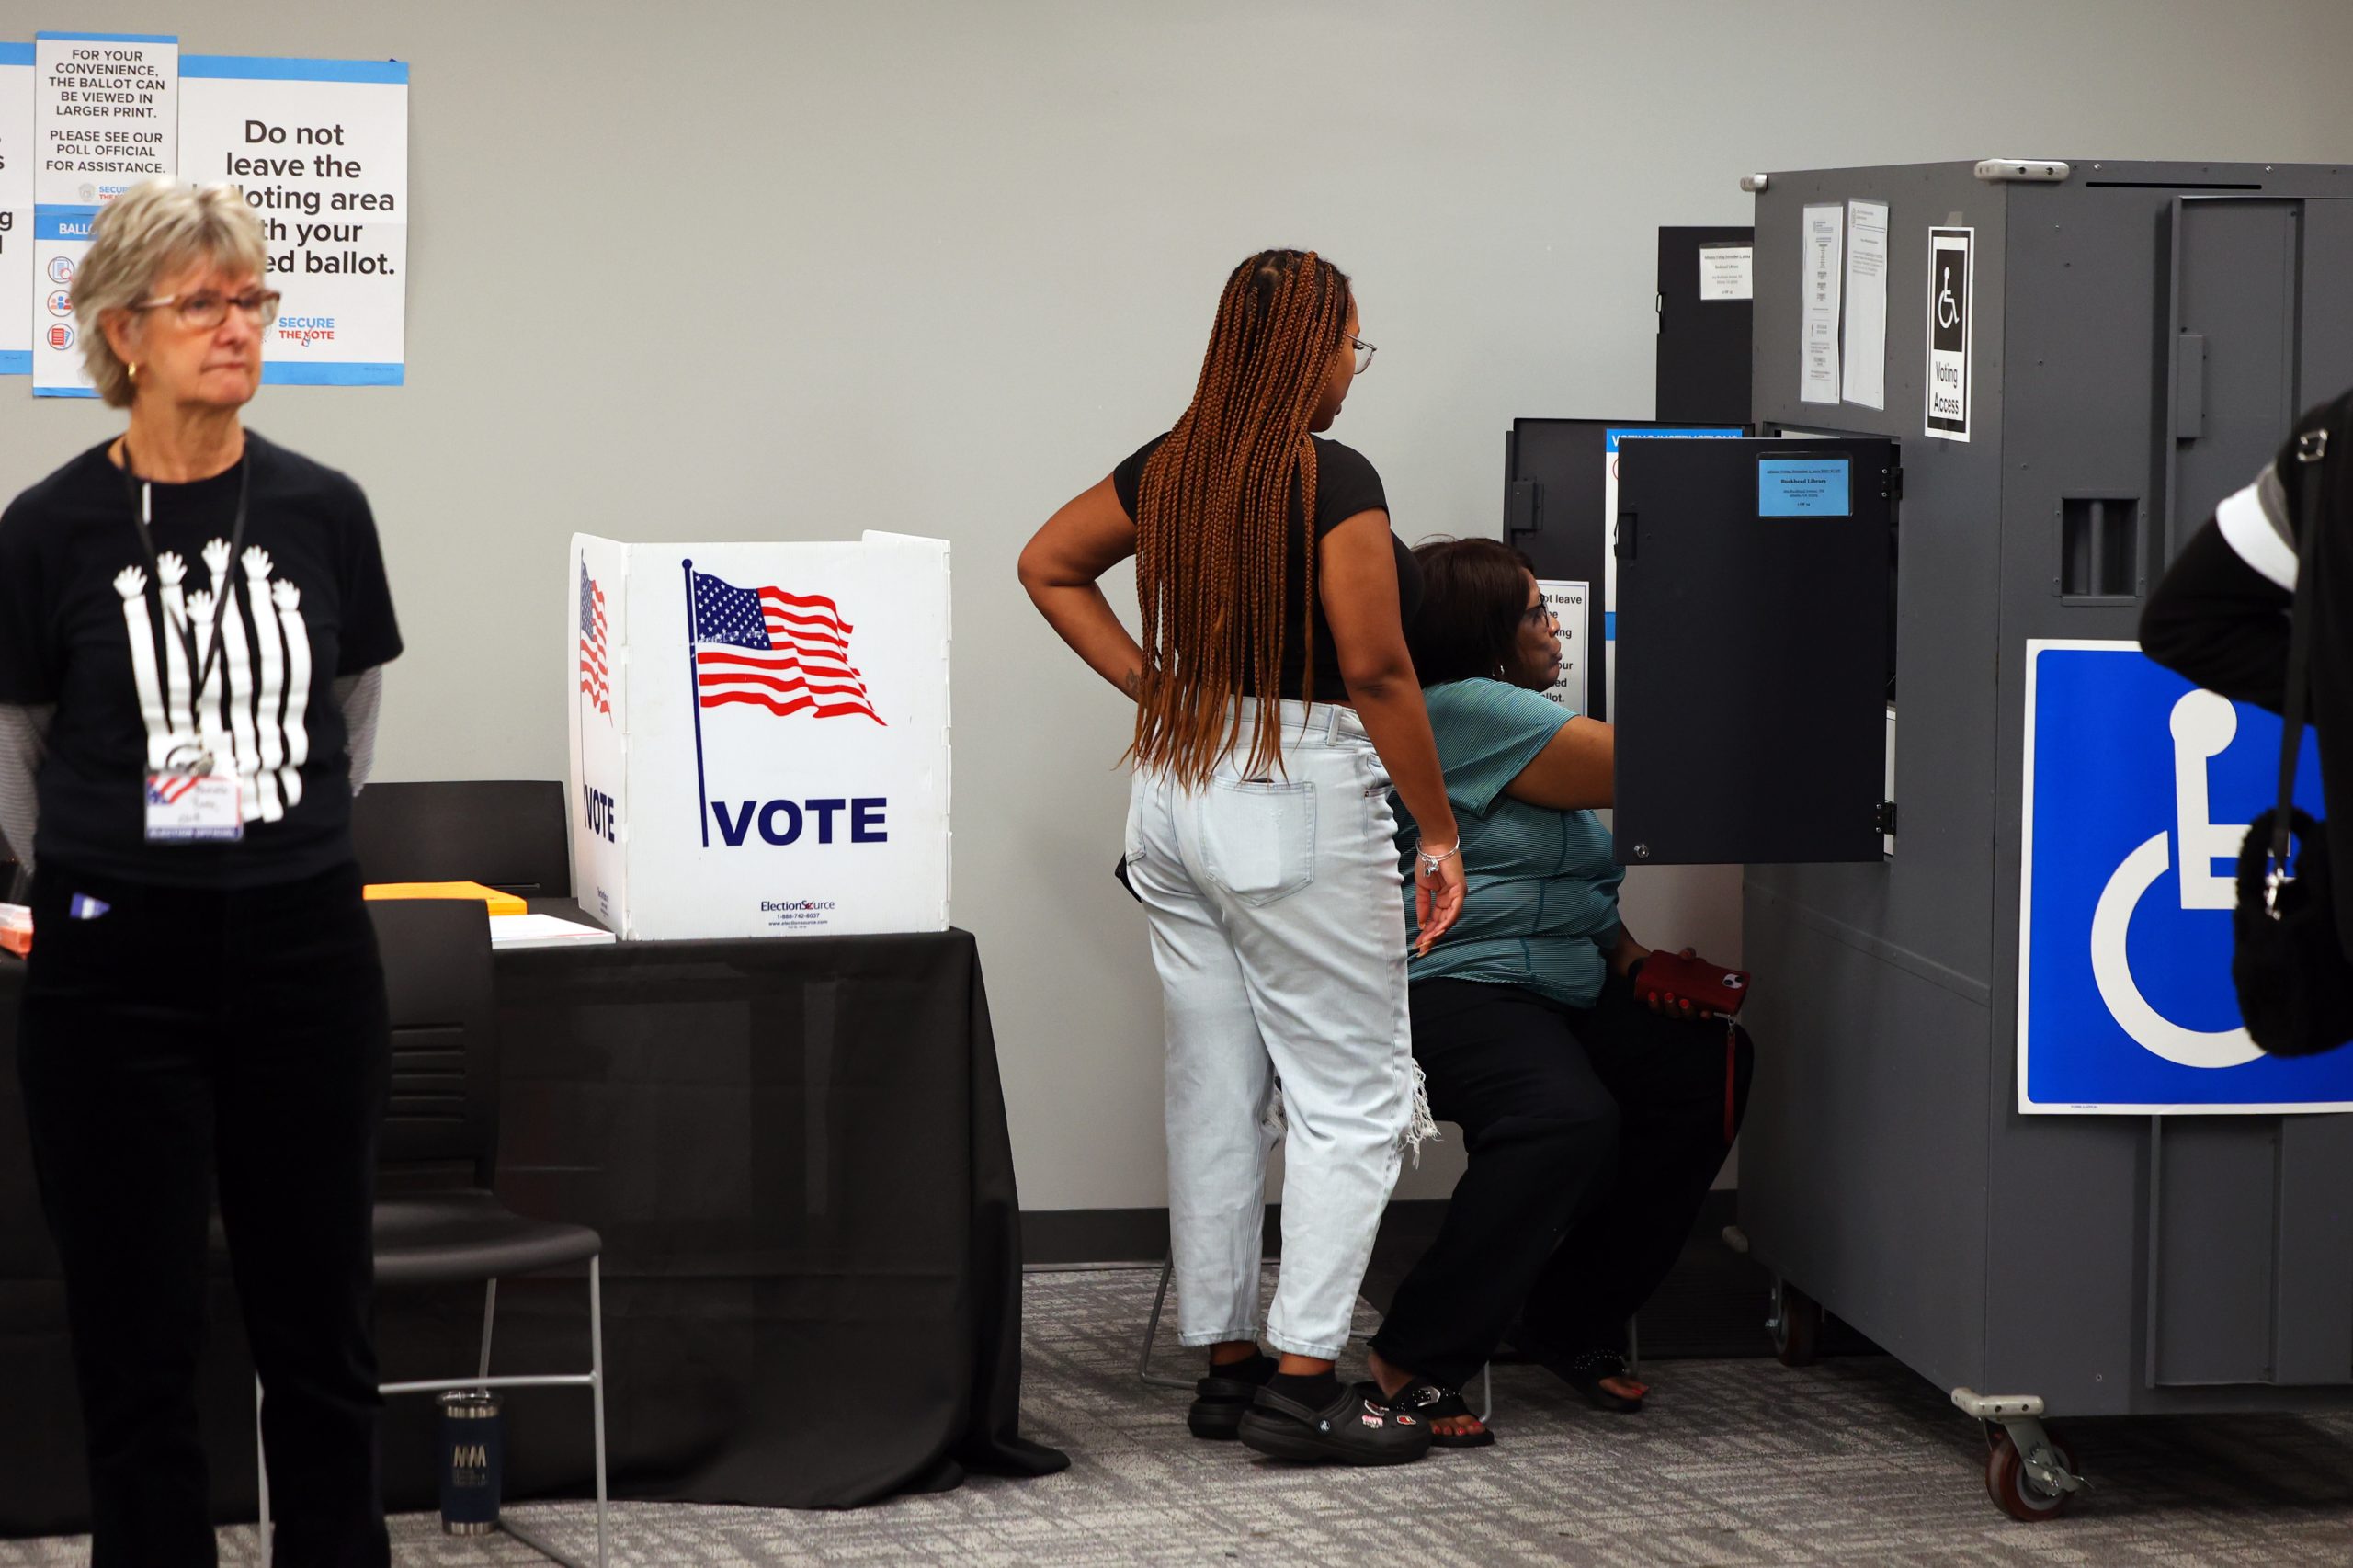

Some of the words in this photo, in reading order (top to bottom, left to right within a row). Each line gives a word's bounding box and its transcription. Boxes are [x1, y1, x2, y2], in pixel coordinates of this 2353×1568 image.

[72, 49, 100, 61] FOR
[104, 50, 142, 62] YOUR
[55, 62, 159, 77] CONVENIENCE,
[49, 76, 75, 87] THE
[79, 77, 132, 89] BALLOT
[135, 79, 165, 90] CAN
[61, 91, 78, 102] BE
[82, 91, 135, 104] VIEWED
[139, 93, 153, 104] IN
[56, 105, 109, 117] LARGER
[113, 107, 157, 119] PRINT.
[50, 130, 101, 142] PLEASE
[104, 131, 130, 142] SEE
[132, 131, 163, 143] OUR
[244, 119, 287, 145] Do
[296, 123, 345, 147] not
[56, 143, 91, 155] POLL
[95, 144, 156, 157] OFFICIAL
[45, 160, 74, 171] FOR
[77, 161, 166, 174] ASSISTANCE.
[226, 152, 305, 177] leave
[313, 154, 362, 179] the
[98, 186, 131, 194] SECU
[330, 191, 395, 211] area
[296, 222, 364, 247] your
[305, 249, 395, 276] ballot.
[278, 317, 335, 329] SECURE
[1935, 360, 1958, 390] Voting
[1933, 391, 1960, 415] Access
[1555, 594, 1583, 604] leave
[585, 783, 615, 844] VOTE
[710, 797, 888, 847] VOTE
